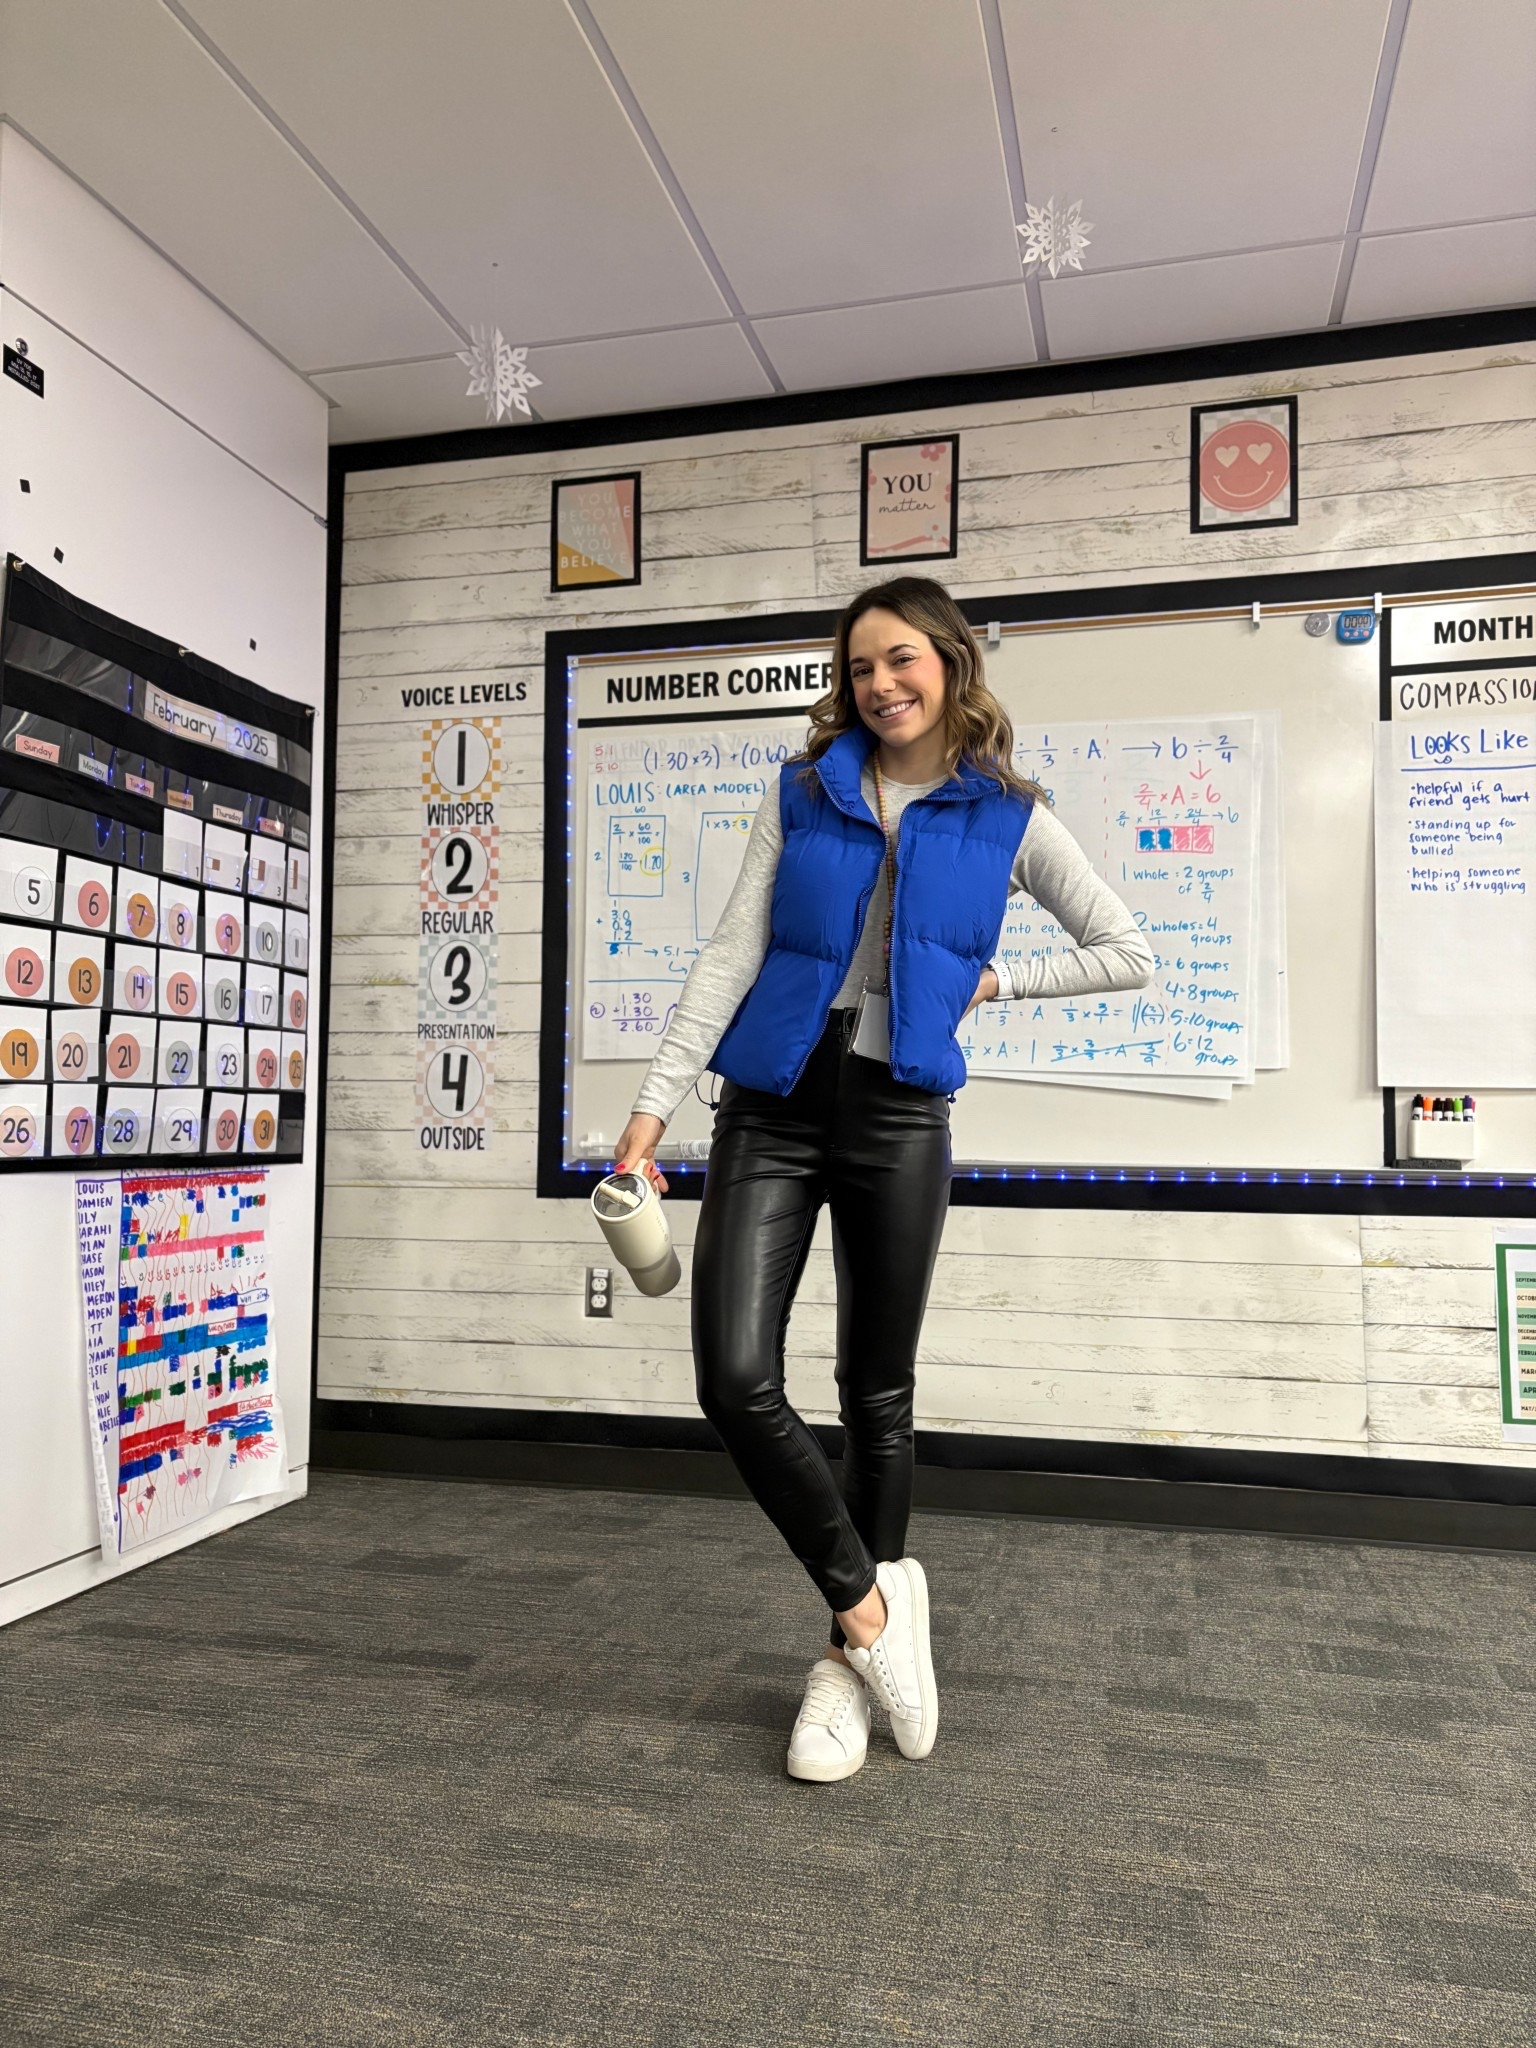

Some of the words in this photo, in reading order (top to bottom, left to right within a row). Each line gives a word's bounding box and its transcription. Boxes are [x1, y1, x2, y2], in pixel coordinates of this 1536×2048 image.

[883, 473, 932, 495] YOU
[879, 498, 936, 514] matter
[560, 551, 628, 569] BELIEVE
[401, 686, 454, 708] VOICE
[460, 682, 527, 705] LEVELS
[607, 671, 720, 704] NUMBER
[152, 693, 217, 742] February
[234, 727, 269, 757] 2025
[23, 740, 53, 759] Sunday
[1480, 728, 1529, 753] Like
[82, 759, 105, 777] Monday
[666, 783, 706, 798] (AREA
[714, 778, 767, 797] MODEL)
[1171, 785, 1185, 805] A
[1416, 781, 1463, 796] helpful
[1471, 780, 1485, 792] if
[1493, 782, 1503, 792] a
[1408, 793, 1454, 808] friend
[1462, 794, 1491, 811] gets
[1500, 791, 1531, 803] hurt
[215, 807, 241, 823] Thursday
[427, 802, 494, 826] WHISPER
[1475, 820, 1491, 831] up
[1499, 817, 1517, 828] for
[1409, 832, 1461, 843] someone
[1469, 832, 1503, 845] being
[1411, 844, 1454, 856] bullied
[445, 837, 474, 895] 2
[1133, 868, 1169, 881] whole
[1183, 866, 1193, 878] 2
[1196, 867, 1234, 884] groups
[1412, 867, 1460, 883] helping
[1468, 867, 1521, 878] someone
[235, 877, 241, 888] 2
[683, 872, 690, 883] 3
[1411, 881, 1438, 892] who
[1446, 881, 1456, 892] is
[1463, 880, 1526, 895] struggling
[27, 879, 41, 905] 5
[276, 886, 282, 897] 3
[1178, 883, 1192, 894] of
[88, 892, 99, 916] 6
[136, 903, 145, 926] 7
[176, 913, 185, 936] 8
[422, 910, 494, 934] REGULAR
[1207, 916, 1217, 931] 4
[225, 925, 233, 946] 9
[1006, 923, 1031, 934] into
[262, 931, 273, 952] 10
[1190, 933, 1232, 948] groups
[1001, 948, 1022, 962] you
[1031, 946, 1052, 957] will
[17, 959, 34, 986] 12
[444, 945, 471, 1005] 3
[1176, 957, 1185, 970] 6
[1190, 960, 1229, 976] groups
[78, 968, 93, 994] 13
[132, 975, 145, 999] 14
[175, 983, 189, 1006] 15
[220, 989, 231, 1010] 16
[262, 994, 272, 1015] 17
[621, 992, 651, 1004] 1.30
[1200, 989, 1239, 1003] groups
[294, 999, 302, 1018] 18
[417, 1023, 496, 1040] PRESENTATION
[619, 1020, 653, 1032] 2.60
[11, 1041, 28, 1067] 19
[62, 1043, 84, 1068] 20
[117, 1045, 132, 1069] 21
[171, 1051, 188, 1074] 22
[221, 1053, 238, 1075] 23
[260, 1058, 274, 1078] 24
[291, 1059, 302, 1079] 25
[441, 1052, 469, 1112] 4
[3, 1117, 30, 1144] 26
[70, 1118, 89, 1144] 27
[112, 1118, 134, 1143] 28
[170, 1119, 193, 1143] 29
[218, 1120, 236, 1142] 30
[259, 1120, 271, 1140] 31
[420, 1126, 486, 1151] OUTSIDE
[77, 1182, 104, 1195] LOUIS
[77, 1196, 113, 1209] DAMIEN
